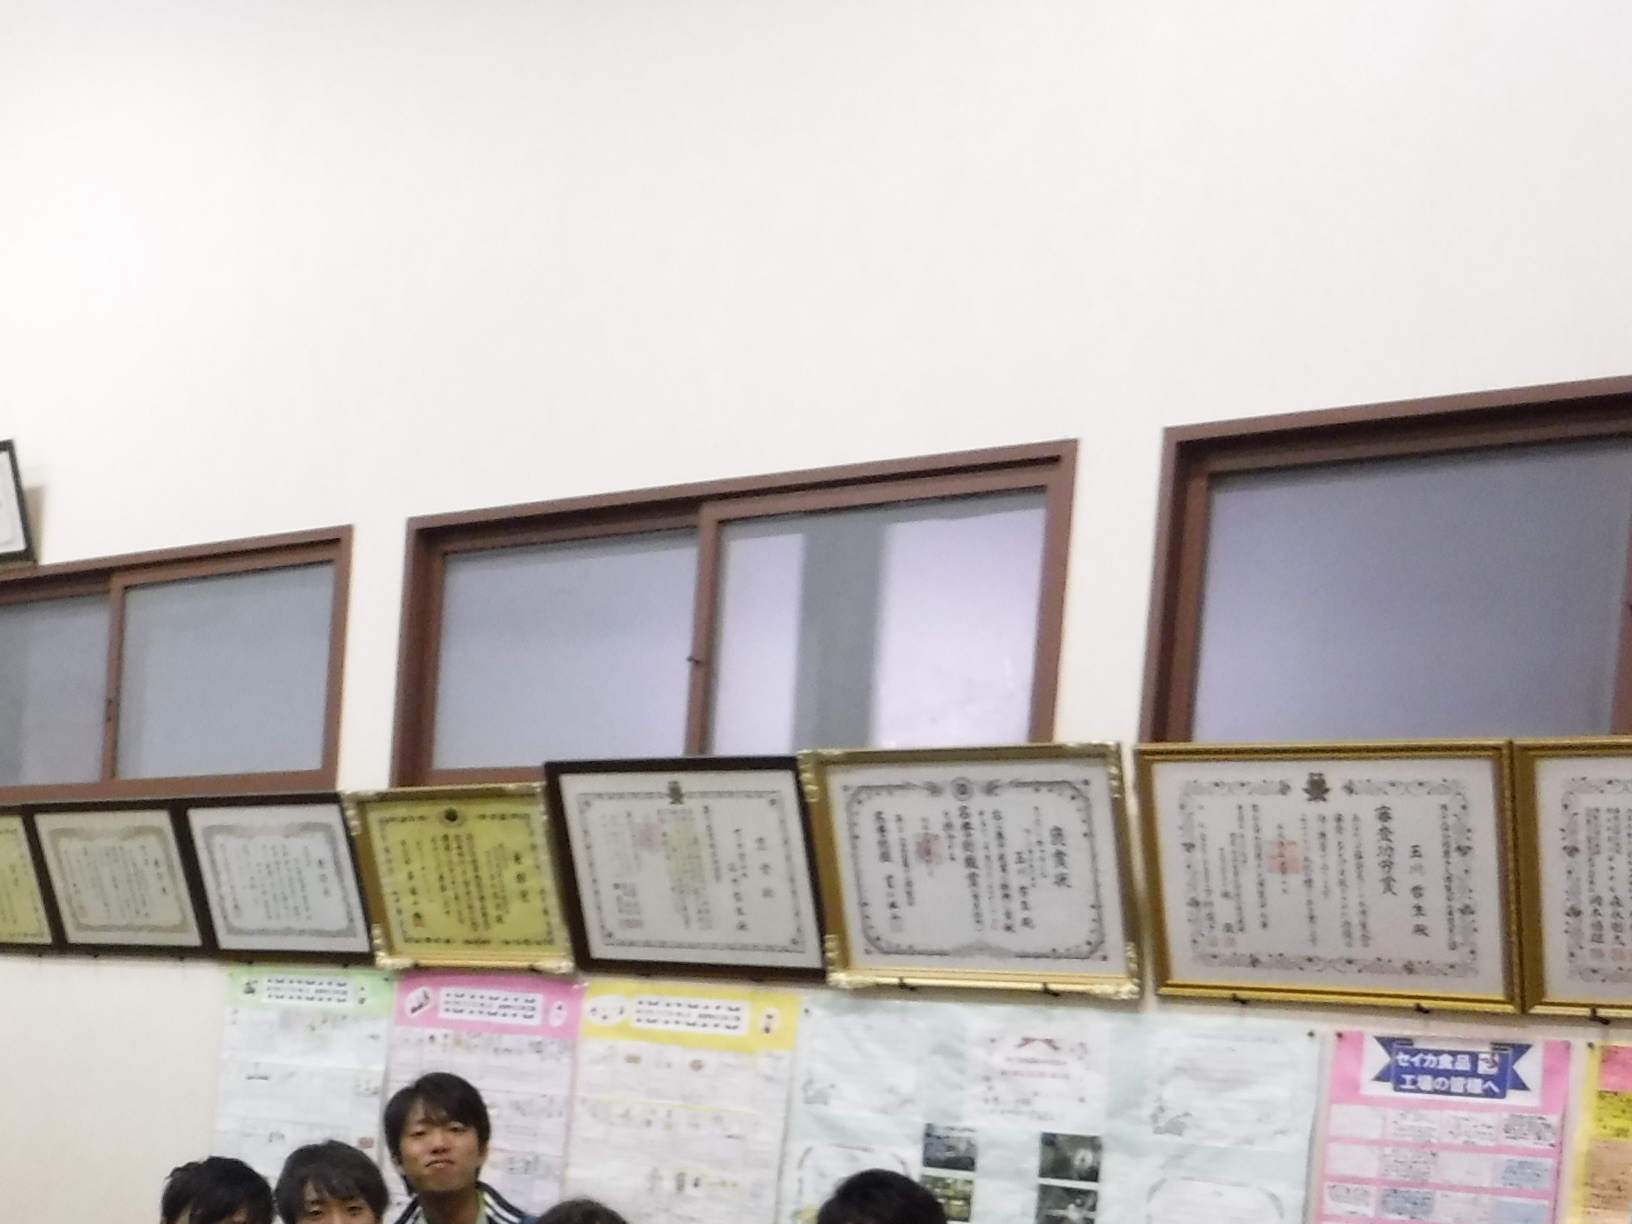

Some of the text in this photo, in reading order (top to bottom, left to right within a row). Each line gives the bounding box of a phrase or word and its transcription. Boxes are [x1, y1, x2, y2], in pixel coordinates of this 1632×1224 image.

[1396, 1051, 1471, 1071] セイカ食品
[1400, 1074, 1501, 1095] 工場の皆様へ
